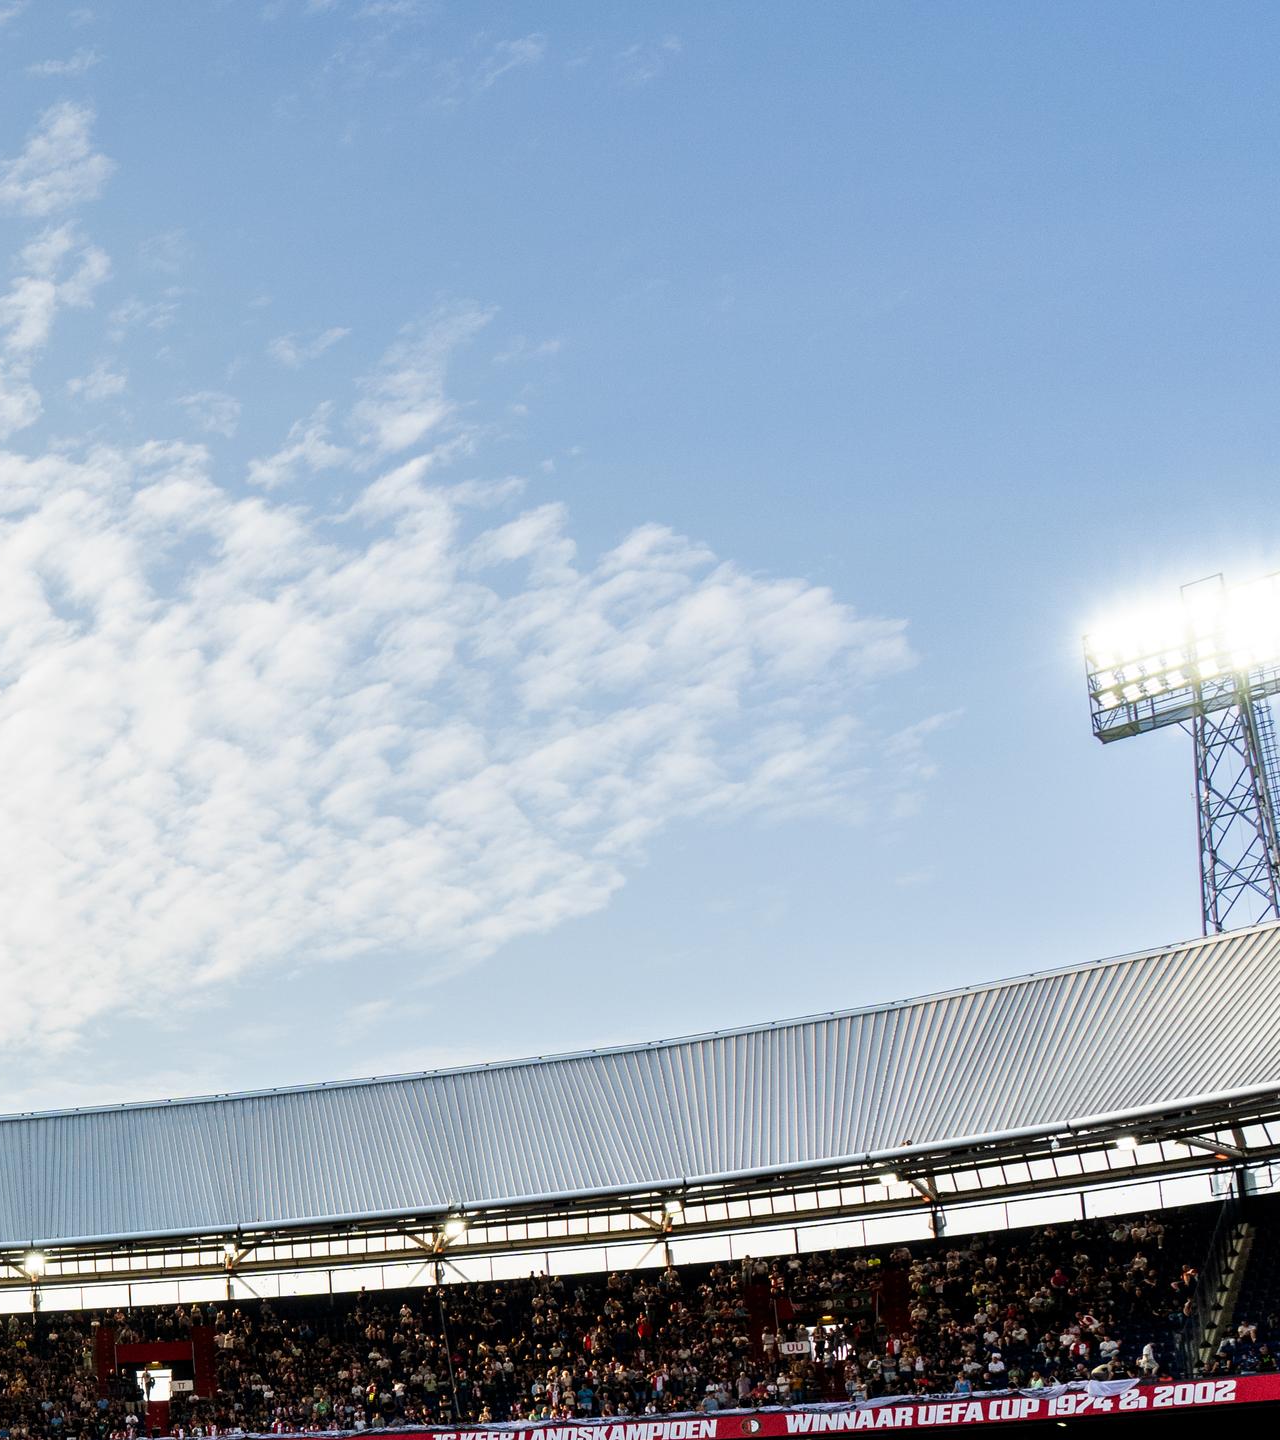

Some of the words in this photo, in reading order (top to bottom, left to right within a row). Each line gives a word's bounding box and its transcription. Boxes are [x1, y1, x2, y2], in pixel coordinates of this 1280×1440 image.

[785, 1406, 913, 1434] WINNAAR
[917, 1401, 984, 1426] UEFA
[988, 1398, 1040, 1420] CUP
[1048, 1395, 1114, 1417] 1974
[1153, 1380, 1237, 1408] 2002
